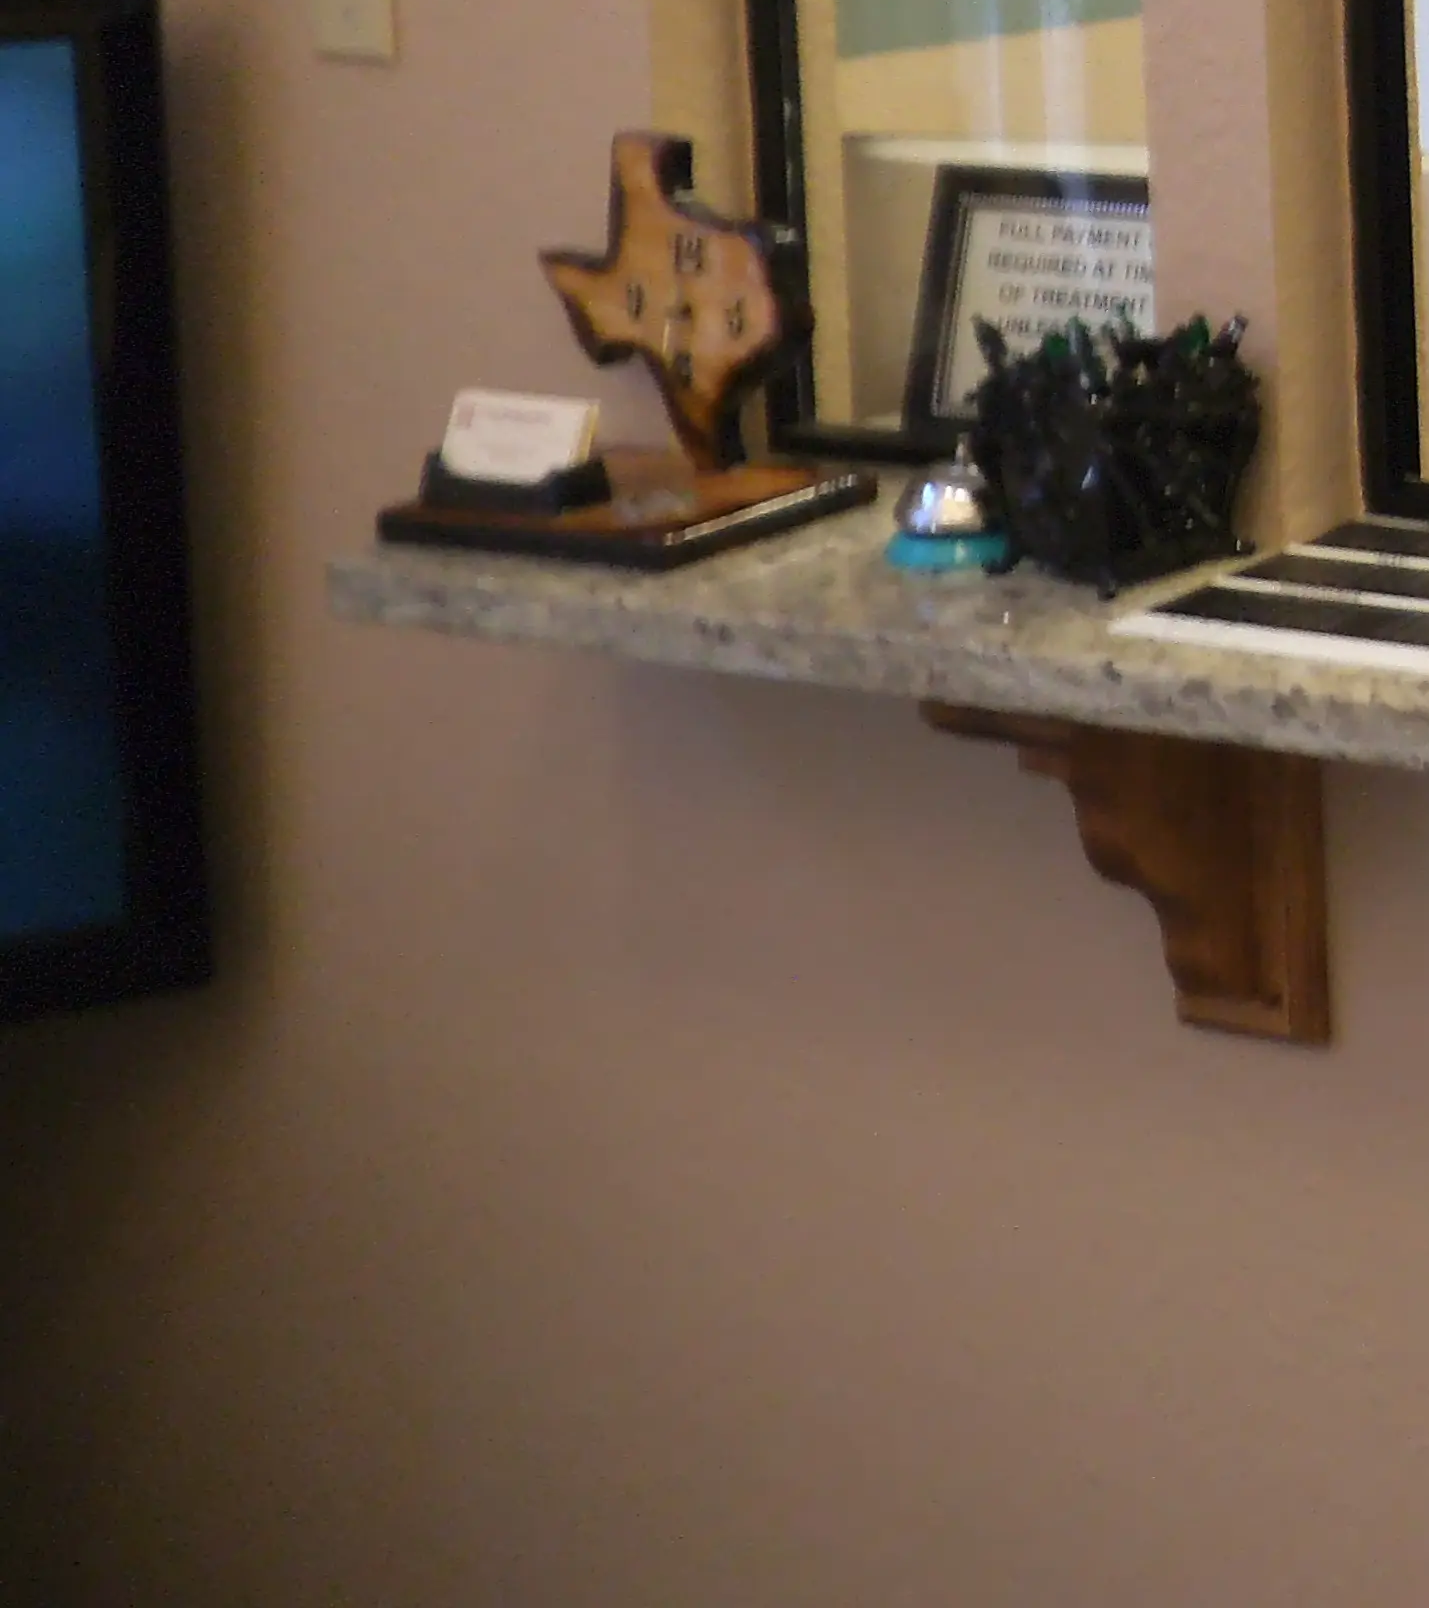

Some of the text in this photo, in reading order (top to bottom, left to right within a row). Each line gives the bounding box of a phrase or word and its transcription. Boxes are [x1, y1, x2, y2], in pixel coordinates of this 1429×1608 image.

[1000, 221, 1143, 247] FULL PAYMENT
[986, 250, 1088, 274] REQUIRED
[1092, 259, 1117, 279] AT
[998, 282, 1148, 314] OF TREATMENT
